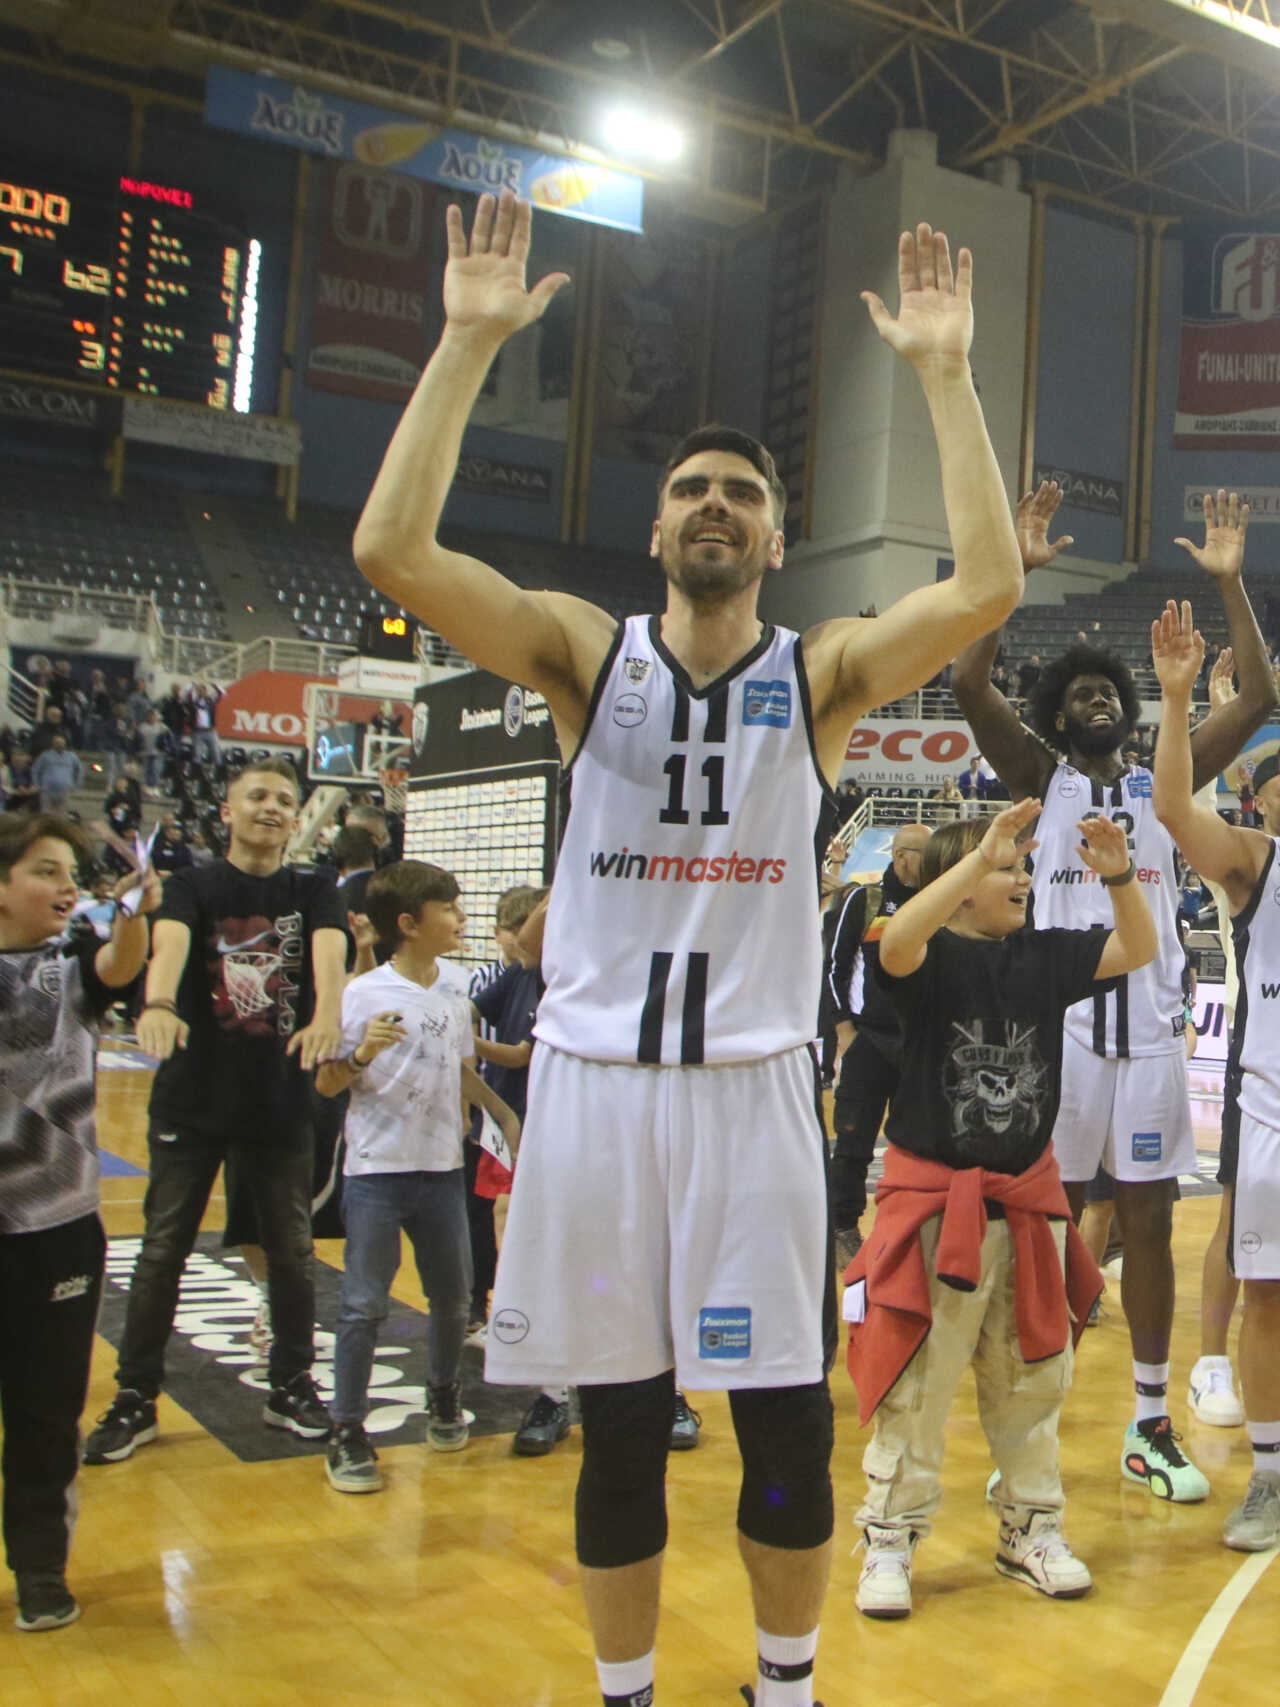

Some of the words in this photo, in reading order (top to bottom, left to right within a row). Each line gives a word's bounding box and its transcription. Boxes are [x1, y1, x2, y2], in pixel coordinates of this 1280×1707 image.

[318, 270, 425, 323] MORRIS
[659, 754, 730, 826] 11
[857, 772, 916, 783] AIMING
[589, 846, 788, 885] winmasters
